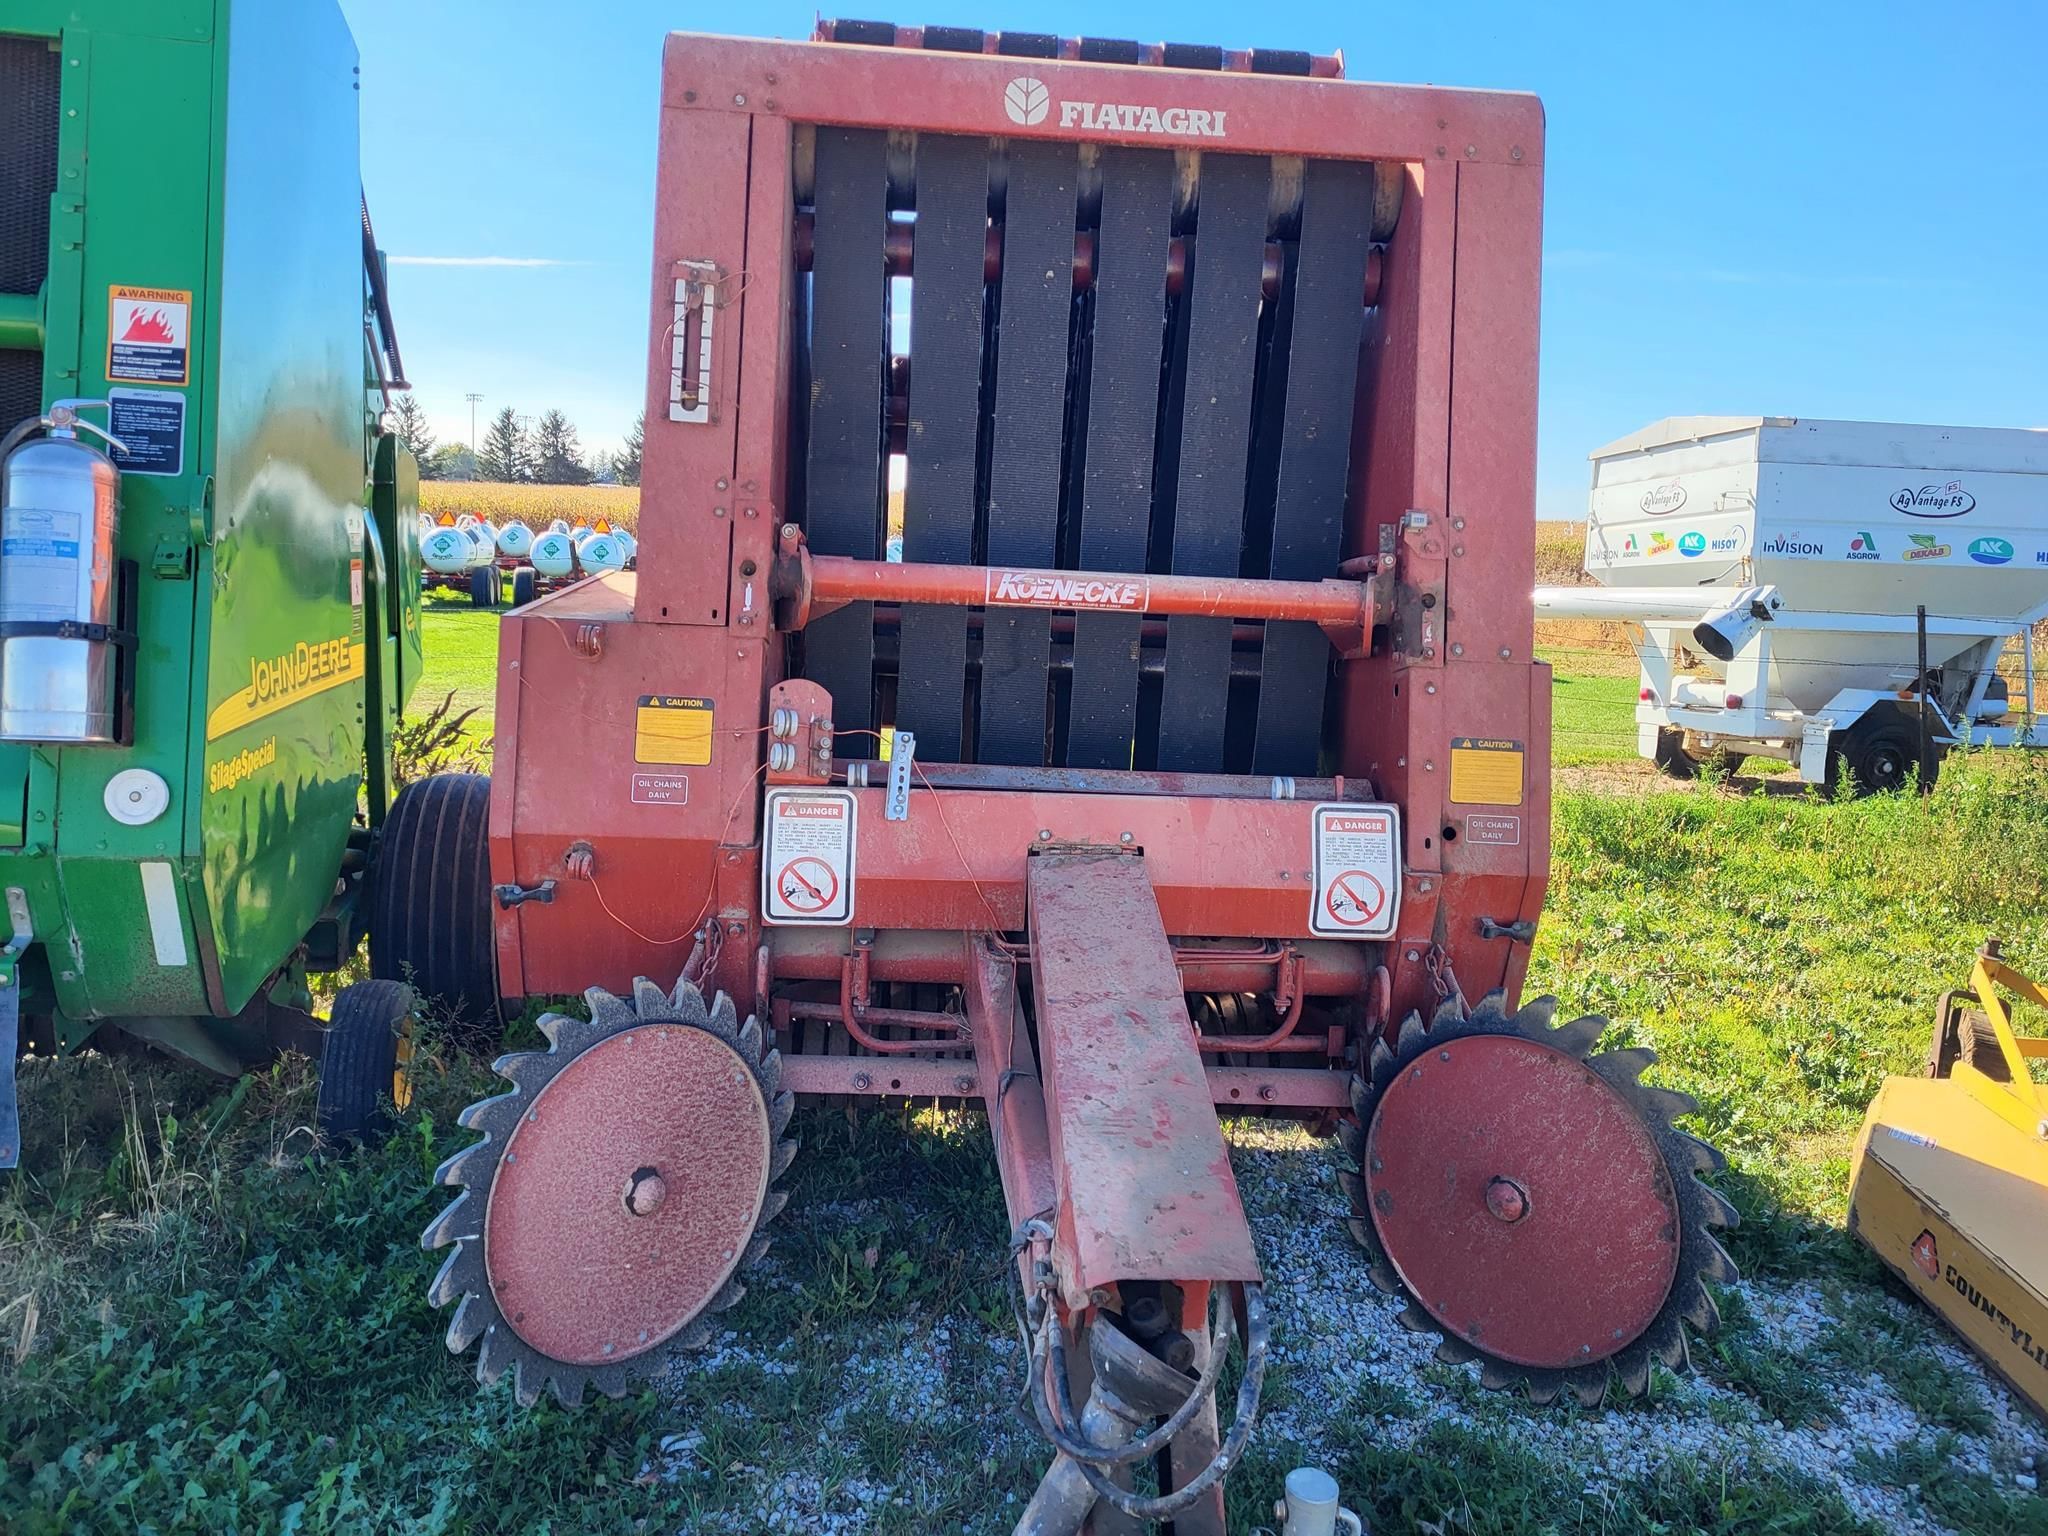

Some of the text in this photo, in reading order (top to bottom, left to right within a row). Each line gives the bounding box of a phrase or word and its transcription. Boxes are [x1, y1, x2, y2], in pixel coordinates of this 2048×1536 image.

[1060, 101, 1227, 137] FIATAGRI
[128, 288, 184, 302] WARNING
[1896, 485, 1963, 510] AgVantage FS
[1684, 535, 1700, 548] NK
[1711, 538, 1738, 550] HISOY
[1763, 540, 1823, 555] InVISION
[1979, 540, 2003, 554] NK
[1846, 552, 1880, 561] ASGROW
[1909, 547, 1944, 560] DEKALB
[995, 573, 1140, 605] KOENECKE
[247, 636, 350, 706] JOHN DEERE
[666, 698, 703, 707] CAUTION
[1478, 740, 1513, 749] CAUTION
[654, 780, 682, 789] CHAINS
[648, 791, 670, 799] DAILY
[800, 807, 839, 816] DANGER
[1344, 821, 1382, 830] DANGER
[1486, 821, 1514, 829] CHAINS
